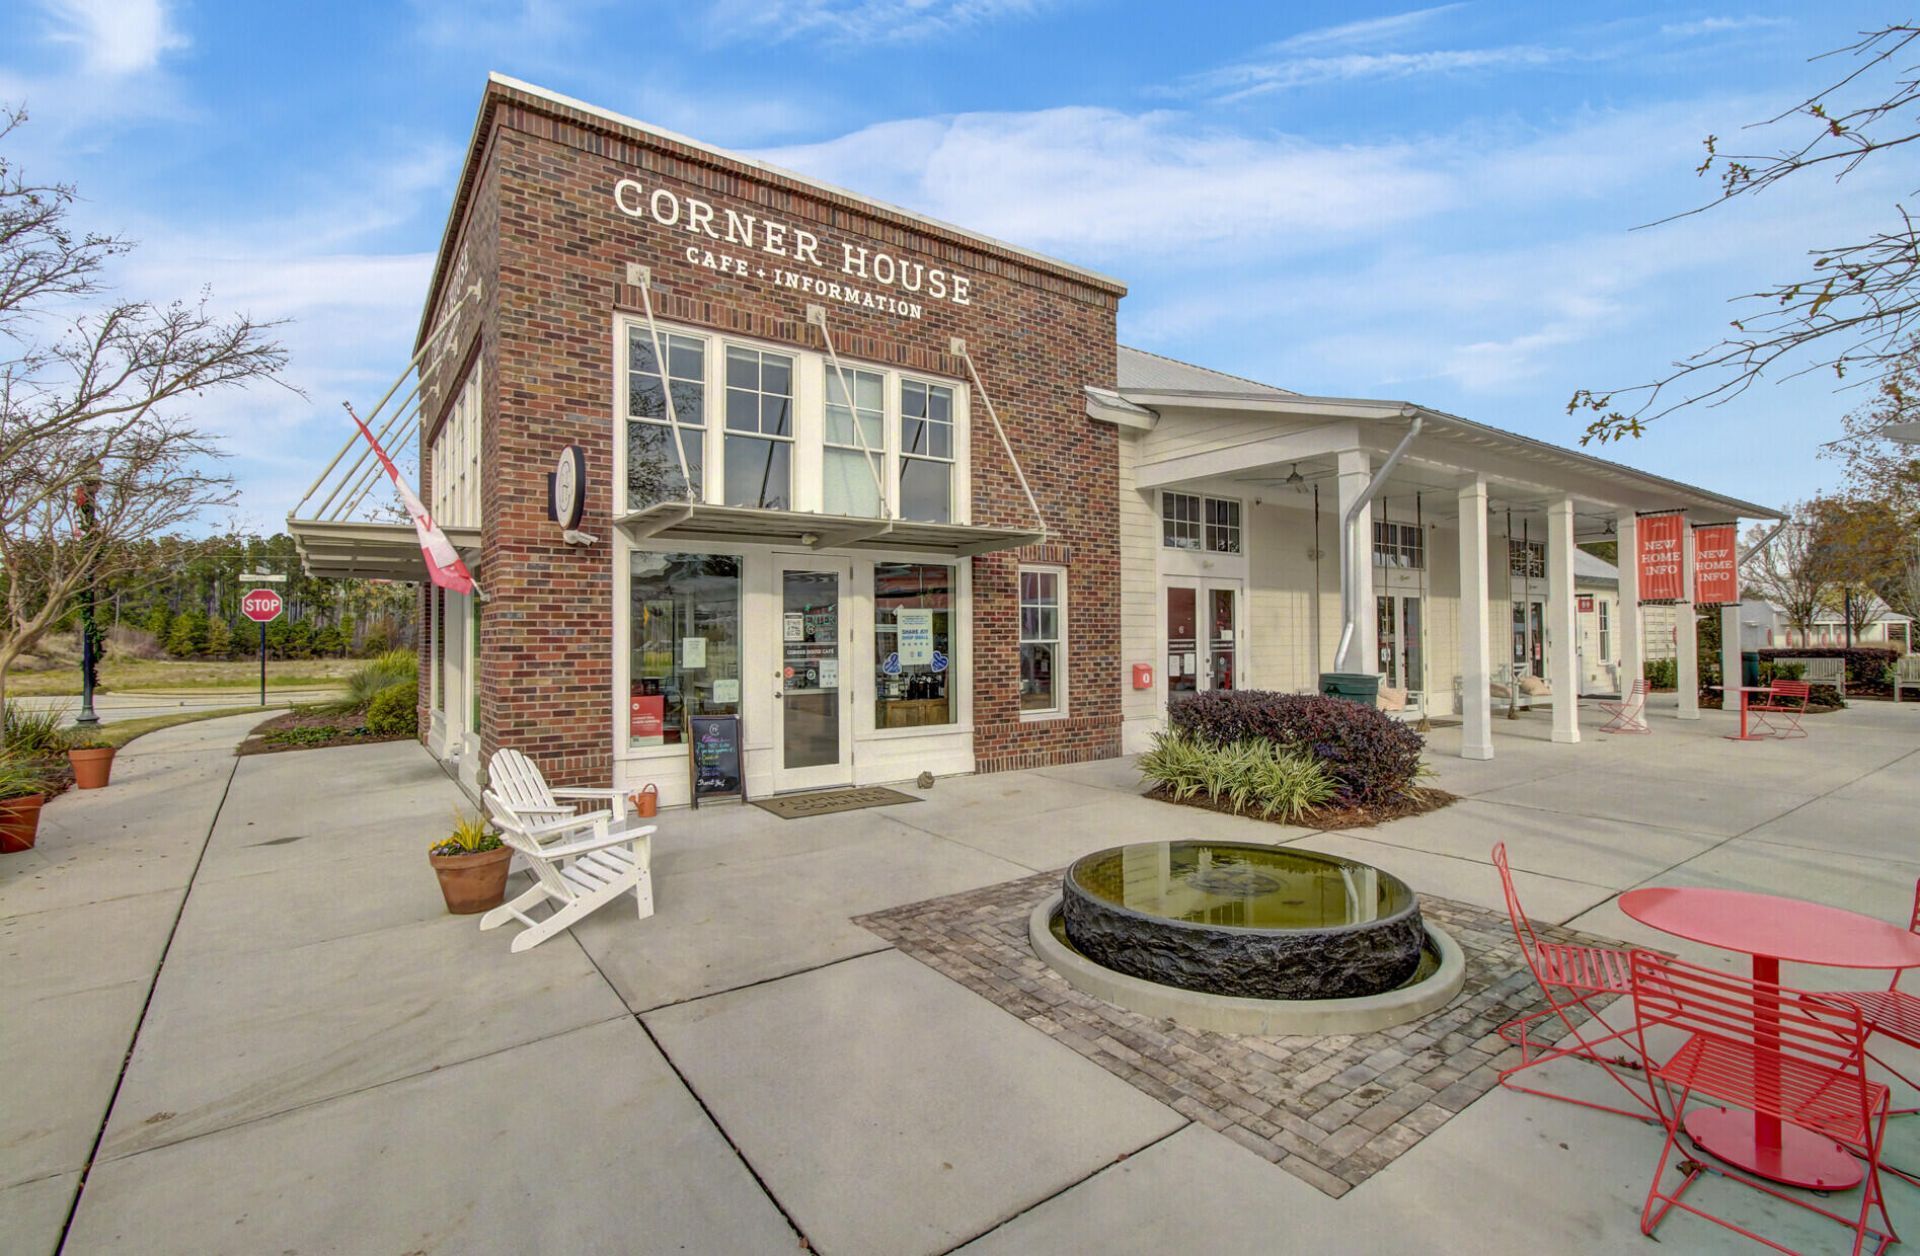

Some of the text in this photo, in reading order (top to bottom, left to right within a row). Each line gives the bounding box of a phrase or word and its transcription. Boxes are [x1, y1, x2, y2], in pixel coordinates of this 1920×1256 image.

[613, 179, 970, 306] CORNER HOUSE
[686, 247, 749, 277] CAFE
[774, 269, 922, 320] INFORMATION
[1644, 539, 1676, 551] NEW
[1641, 551, 1681, 563] HOME
[1698, 549, 1729, 559] NEW
[1645, 565, 1678, 576] INFO
[1695, 560, 1733, 571] HOME
[1699, 572, 1729, 582] INFO
[245, 598, 280, 612] STOP
